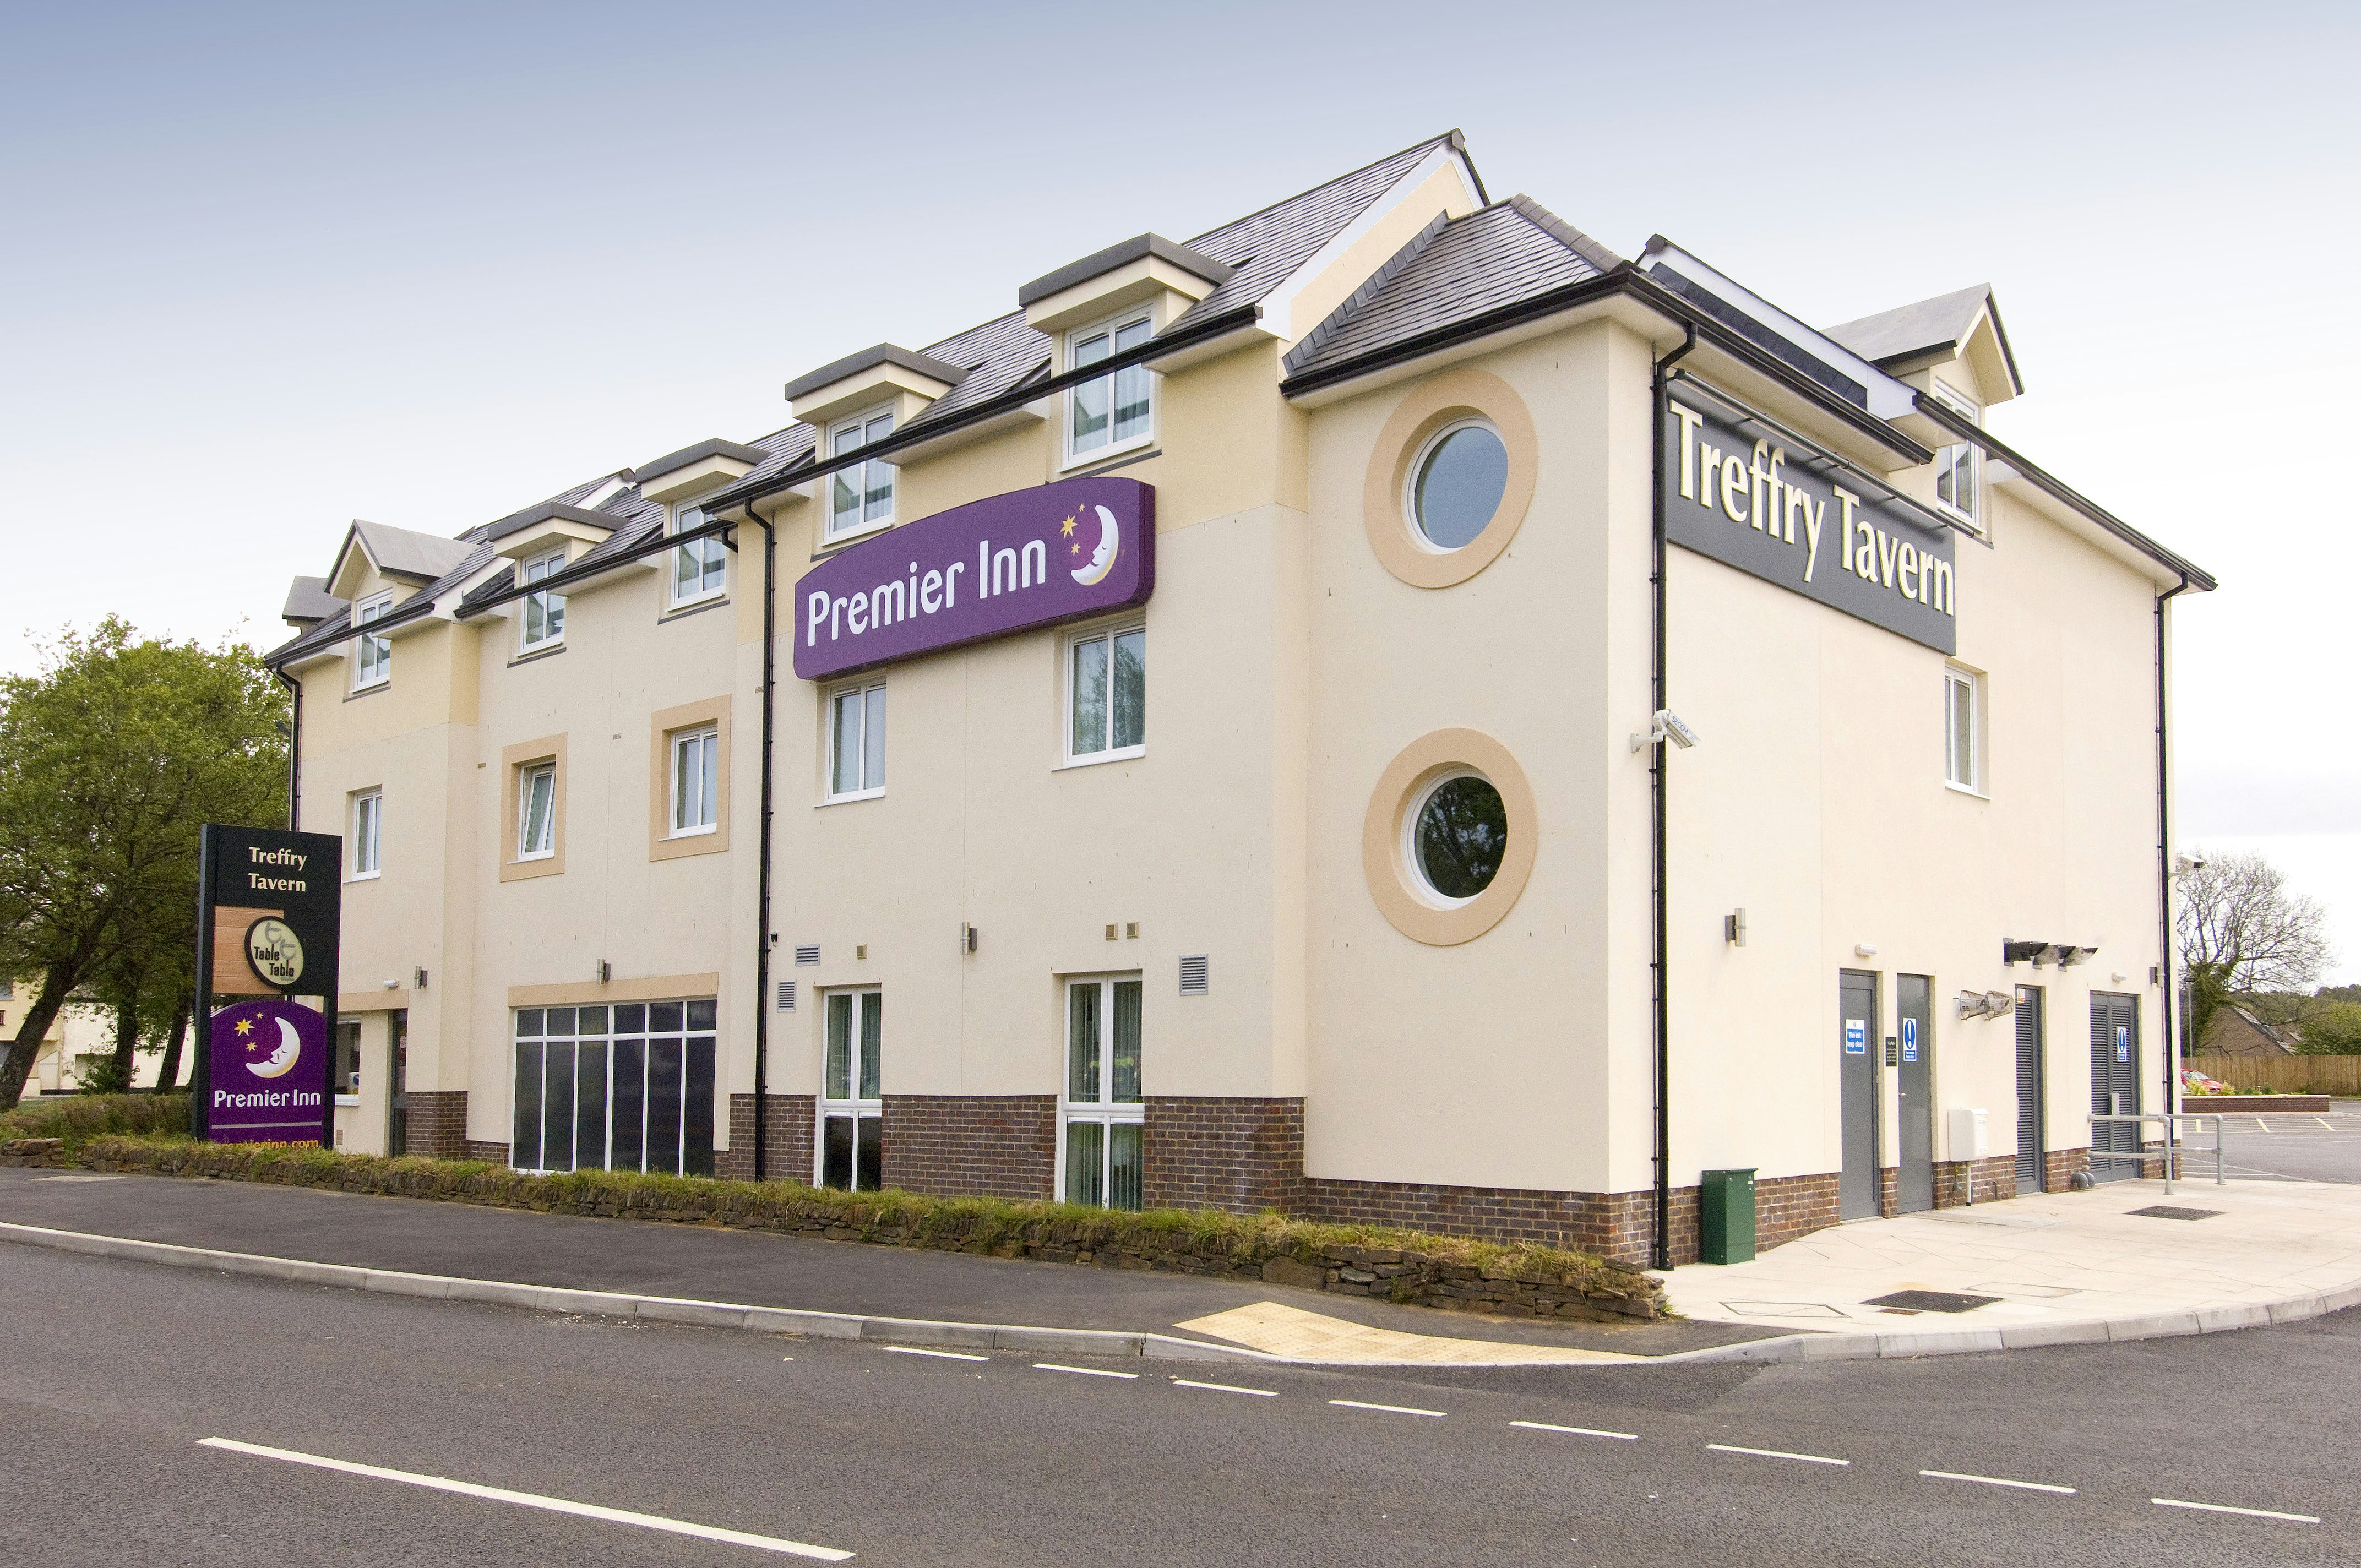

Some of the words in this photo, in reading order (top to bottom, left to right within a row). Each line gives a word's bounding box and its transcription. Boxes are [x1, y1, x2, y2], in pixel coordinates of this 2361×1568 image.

[1670, 399, 1825, 582] Treffry
[1833, 485, 1954, 616] Tavern
[808, 561, 964, 646] Premier
[978, 539, 1046, 598] Inn
[249, 847, 307, 871] Treffry
[248, 873, 306, 892] Tavern
[254, 944, 279, 961] Table
[269, 960, 295, 977] Table
[214, 1090, 290, 1108] Premier
[293, 1089, 320, 1106] Inn
